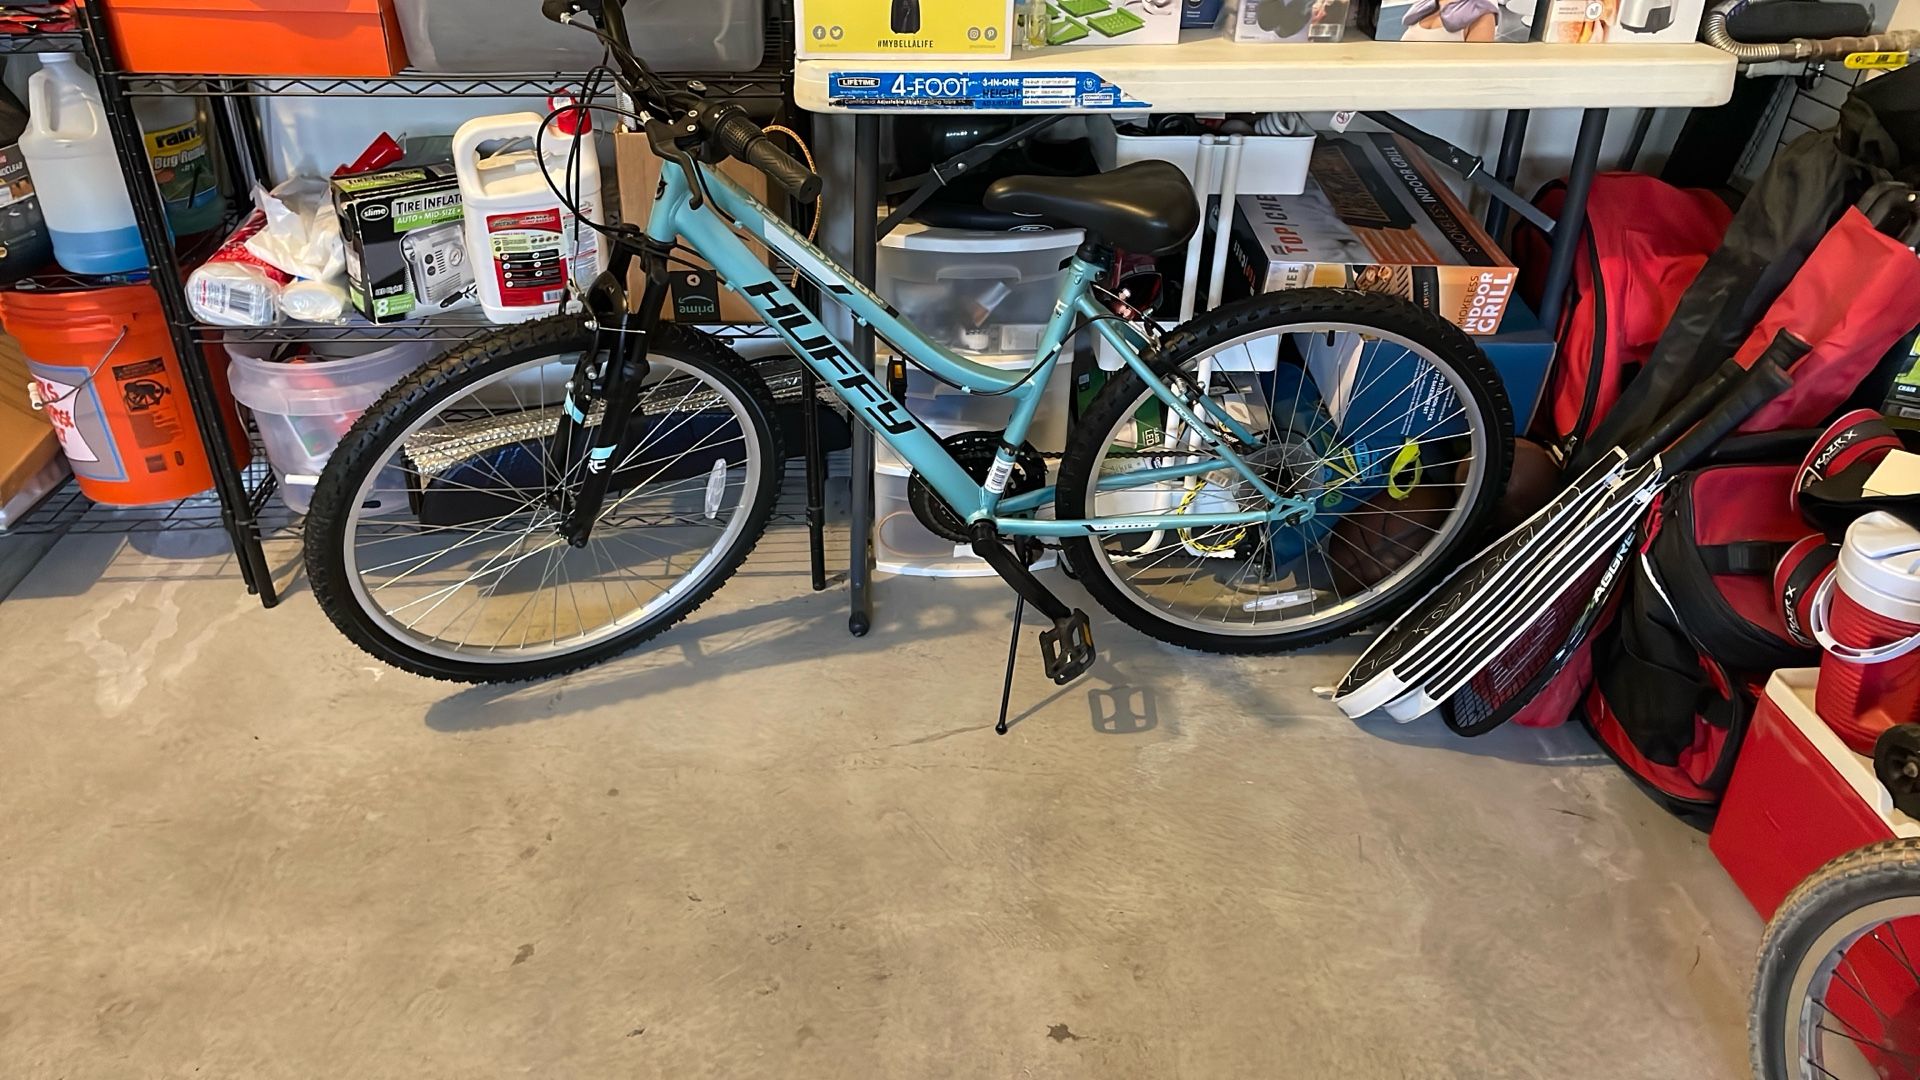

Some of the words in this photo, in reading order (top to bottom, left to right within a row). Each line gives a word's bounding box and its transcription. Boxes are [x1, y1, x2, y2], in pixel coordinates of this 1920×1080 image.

[877, 40, 934, 48] #MYBELLALIFE
[891, 74, 969, 97] 4-FOOT
[982, 77, 1020, 86] 3-IN-ONE
[154, 154, 178, 170] Bug
[1399, 168, 1438, 204] INDOOR
[363, 207, 386, 218] slime
[396, 199, 420, 214] TIRE
[397, 215, 418, 225] AUTO
[424, 208, 456, 220] MID-SIZE
[1273, 226, 1309, 254] TOP
[376, 299, 388, 316] 8
[679, 303, 715, 316] prime
[1462, 271, 1494, 333] INDOOR
[1476, 272, 1513, 333] GRILL
[743, 281, 917, 435] HUFFY
[1897, 384, 1917, 393] CHAIR
[1144, 428, 1155, 446] LED
[1843, 429, 1859, 441] X
